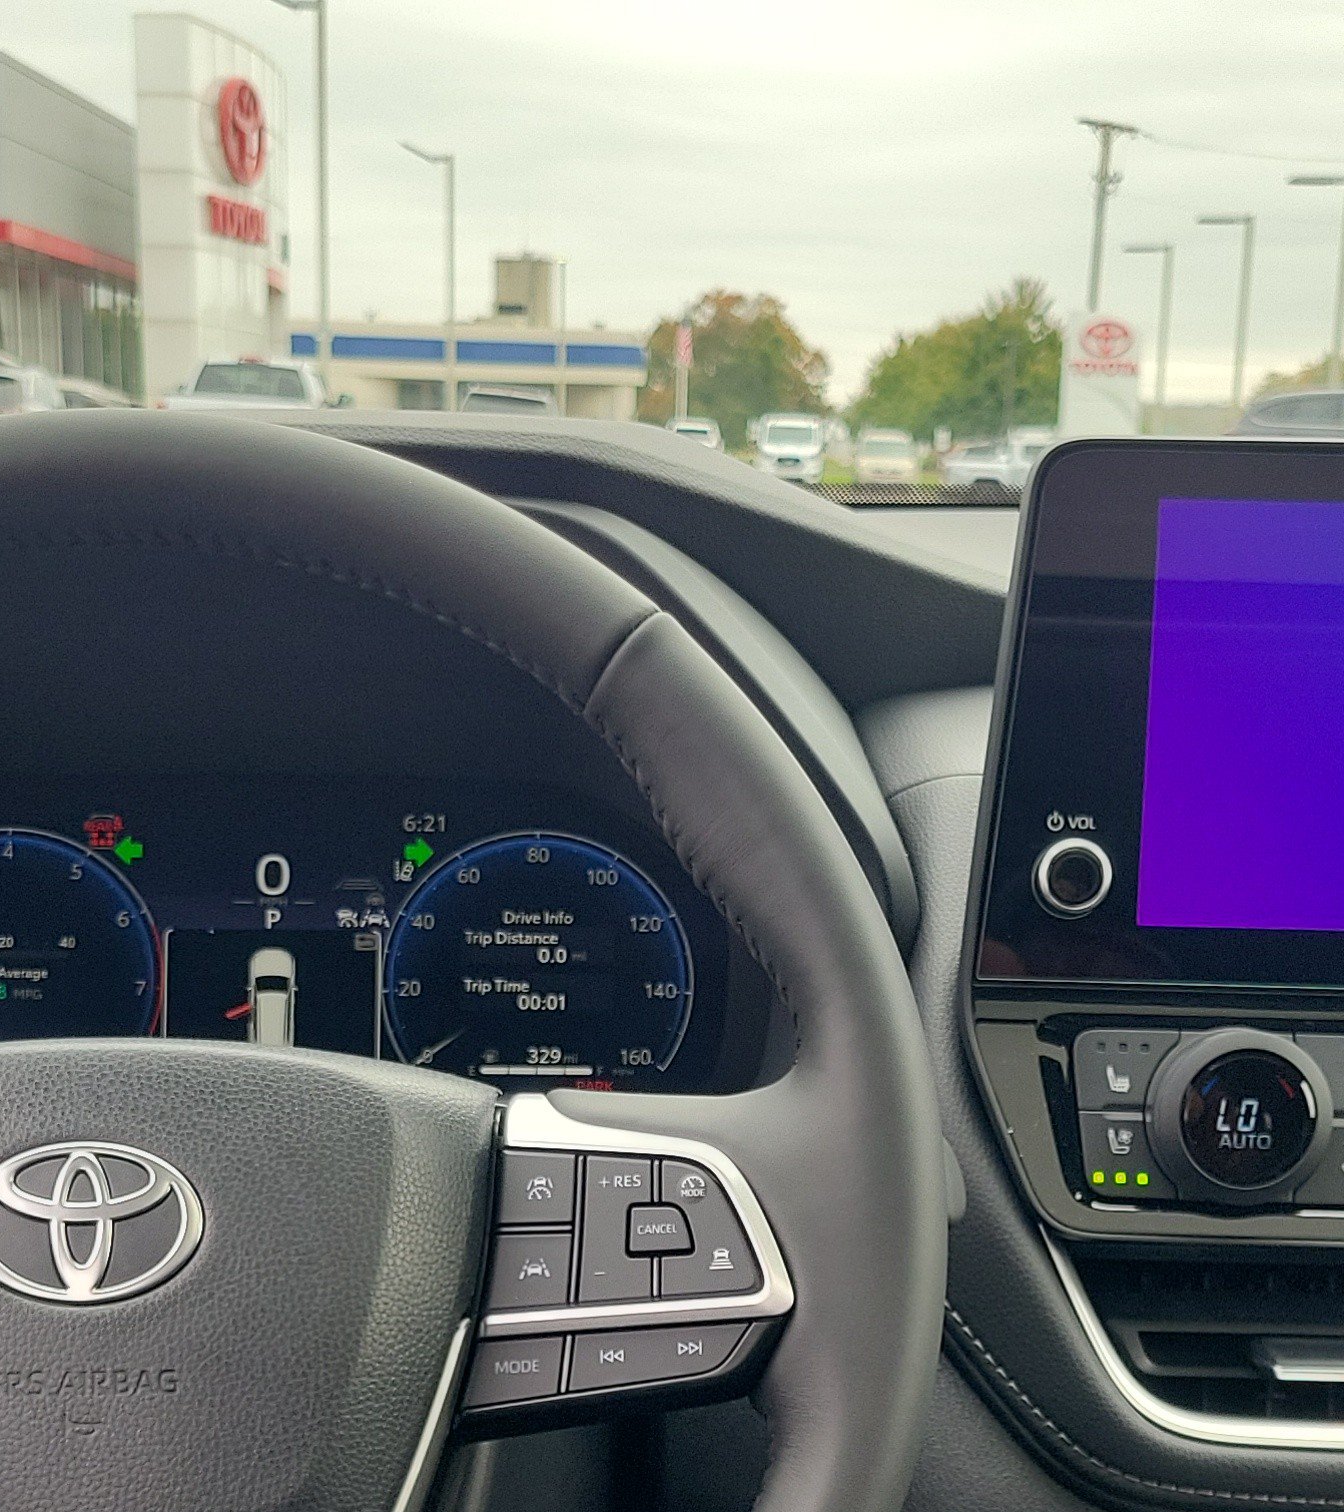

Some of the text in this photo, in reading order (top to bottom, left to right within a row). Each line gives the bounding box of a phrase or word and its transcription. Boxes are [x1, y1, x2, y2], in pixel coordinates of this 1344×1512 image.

[402, 814, 447, 833] 6:21
[1067, 816, 1096, 830] VOL
[0, 841, 14, 859] 4
[526, 846, 550, 865] 80
[69, 864, 83, 881] 5
[256, 853, 291, 896] 0
[457, 867, 481, 885] 60
[587, 868, 619, 886] 100
[117, 911, 131, 928] 6
[264, 907, 282, 930] P
[411, 914, 436, 931] 40
[502, 909, 574, 925] Drive Info
[629, 915, 662, 934] 120
[58, 936, 76, 949] 40
[464, 930, 559, 948] Trip Distance
[537, 946, 567, 964] 0.0
[134, 980, 148, 997] 7
[397, 980, 421, 998] 20
[463, 977, 531, 996] Trip Time
[644, 982, 677, 1000] 140
[517, 992, 567, 1011] 00:01
[525, 1046, 562, 1065] 329
[620, 1048, 652, 1066] 160
[1218, 1134, 1272, 1150] AUTO
[680, 1189, 705, 1197] MODE
[637, 1223, 677, 1234] CANCEL
[494, 1360, 541, 1374] MODE
[50, 1369, 179, 1398] AIRBAG
